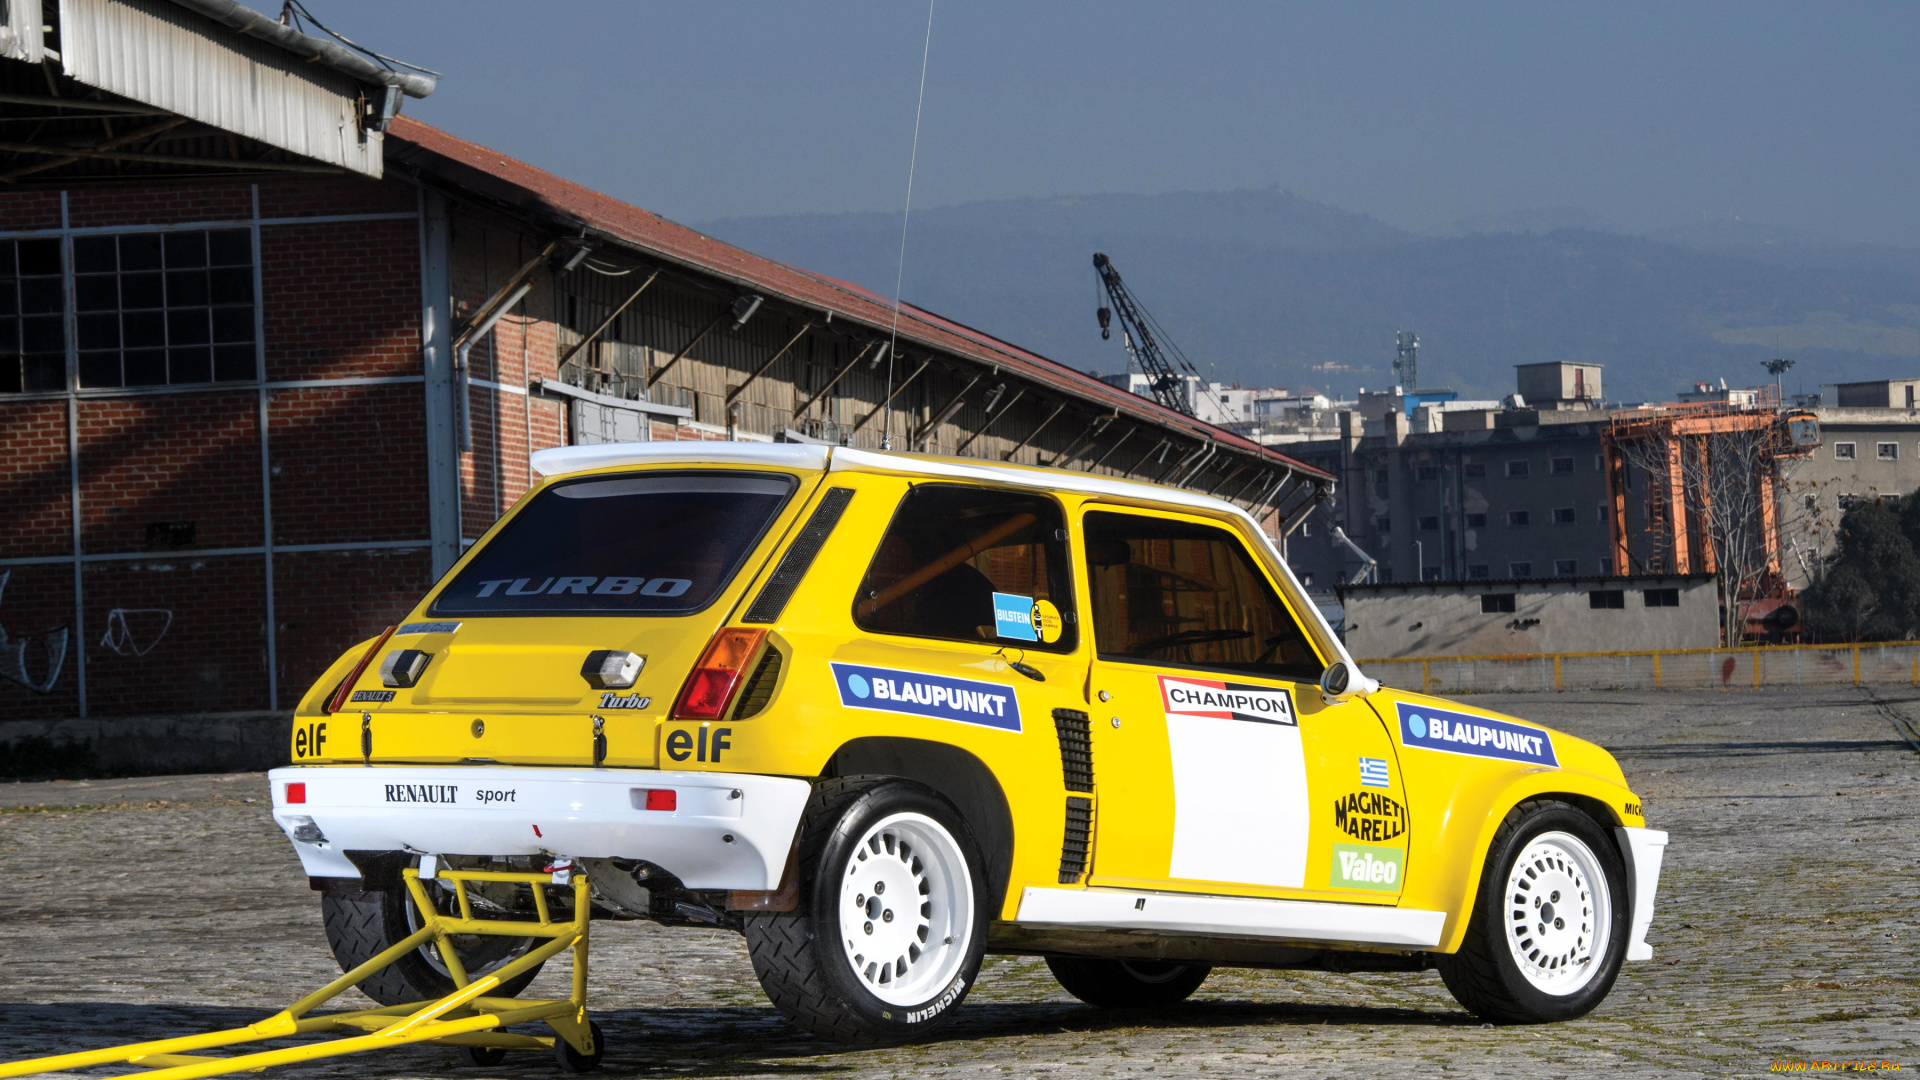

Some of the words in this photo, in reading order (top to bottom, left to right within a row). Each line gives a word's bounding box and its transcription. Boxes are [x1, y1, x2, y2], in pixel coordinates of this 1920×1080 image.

[476, 576, 693, 598] TURBO
[996, 608, 1031, 625] BILSTEIN
[351, 691, 387, 701] RENAULT
[385, 691, 394, 701] 5
[597, 693, 652, 710] Turbo
[872, 677, 1007, 717] BLAUPUNKT
[1170, 688, 1287, 714] CHAMPION
[296, 723, 327, 758] elf
[666, 726, 732, 763] elf
[1429, 718, 1543, 757] BLAUPUNKT
[384, 784, 458, 804] RENAULT
[475, 788, 516, 804] sport
[1334, 791, 1406, 824] MAGNETI
[1624, 802, 1645, 817] MICH
[1334, 808, 1406, 842] MARELLI
[1338, 850, 1397, 884] Valeo
[906, 977, 966, 1024] MICHELIN
